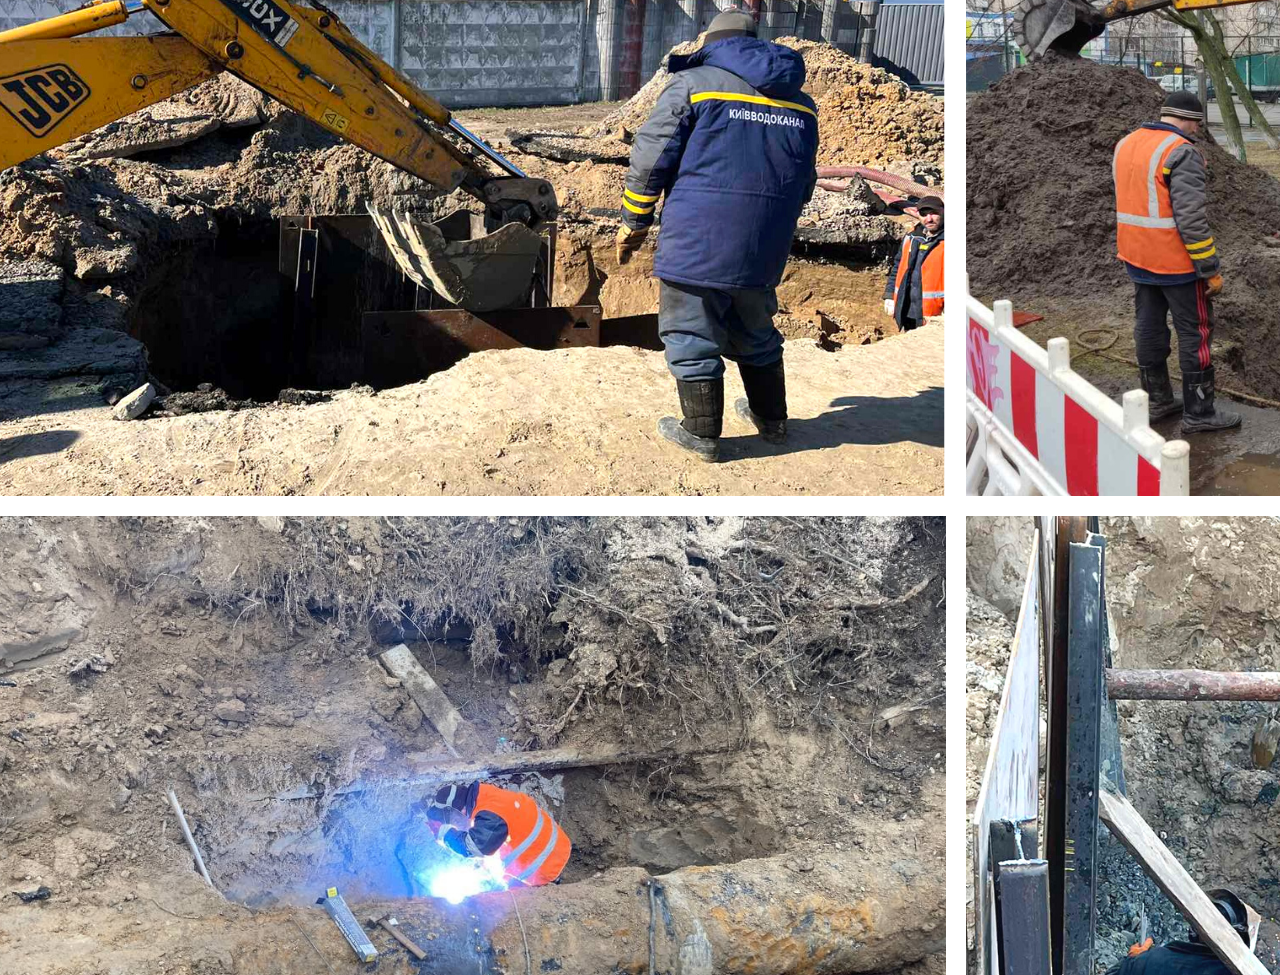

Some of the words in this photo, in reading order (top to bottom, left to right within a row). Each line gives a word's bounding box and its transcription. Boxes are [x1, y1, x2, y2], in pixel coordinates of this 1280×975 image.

[242, 0, 283, 32] CX
[2, 70, 84, 129] JCB
[729, 108, 805, 129] КИЇВВОДОКАНАЛ
